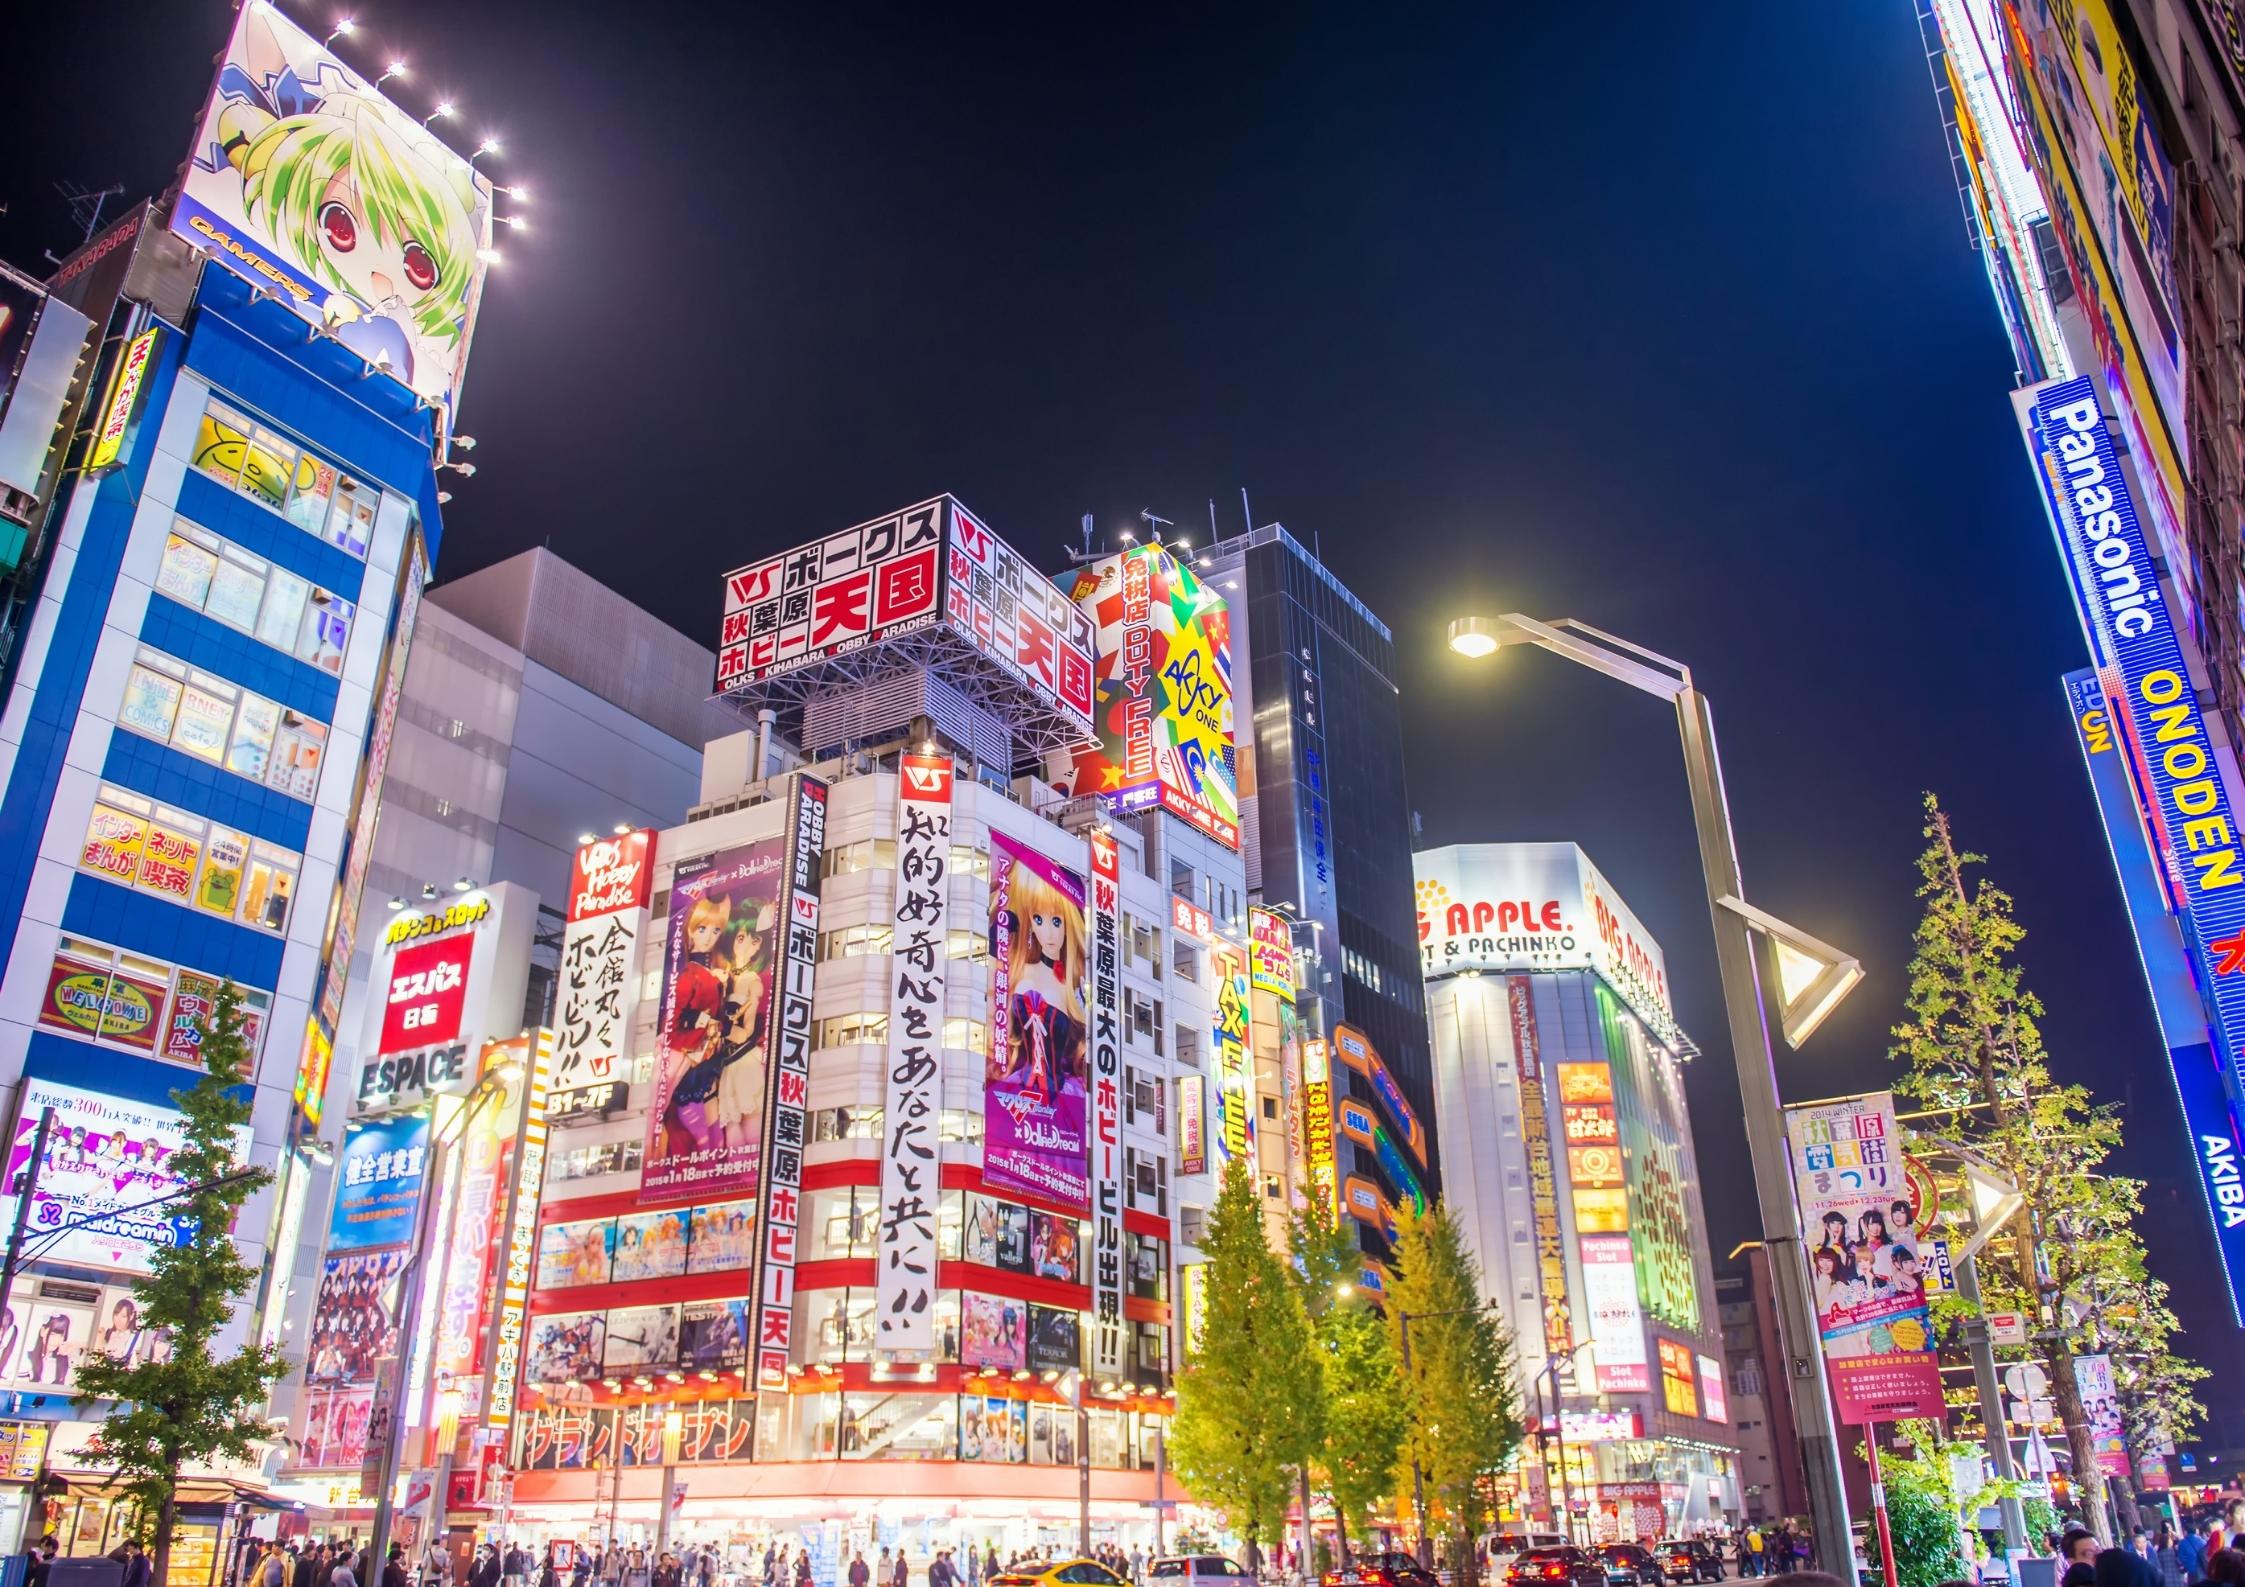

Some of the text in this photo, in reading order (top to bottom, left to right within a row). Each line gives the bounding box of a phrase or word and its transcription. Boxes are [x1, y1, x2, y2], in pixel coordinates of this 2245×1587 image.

[188, 215, 313, 303] GAMERS
[786, 506, 940, 594] ボークス
[2050, 398, 2153, 638] Panasonic
[723, 593, 808, 644] 秋葉原
[812, 548, 936, 648] 天国
[949, 583, 1013, 652] ホビー
[950, 547, 1014, 627] 秋葉原
[996, 552, 1093, 658] ボークス
[1123, 557, 1149, 624] 免税店
[719, 633, 807, 678] ホビー
[872, 614, 937, 644] PARADISE
[1018, 607, 1092, 716] 天国
[1124, 625, 1151, 697] DUTY
[1125, 699, 1152, 780] FREE
[1195, 709, 1219, 734] ONE
[2141, 669, 2244, 890] ONODEN
[84, 840, 191, 895] まんが 喫茶
[93, 812, 197, 863] インター ネット
[796, 780, 813, 888] PARADISE
[1469, 936, 1576, 953] PACHINKO
[61, 986, 147, 1022] WELCOME
[389, 961, 461, 1004] エスパス
[1219, 952, 1243, 1038] TAX
[168, 1048, 195, 1061] AKIBA
[359, 1045, 467, 1100] ESPACE
[1346, 1109, 1371, 1135] SEGA
[1815, 1166, 1887, 1194] まつり
[2202, 1133, 2245, 1230] AKIBA
[1603, 1485, 1623, 1498] BIG
